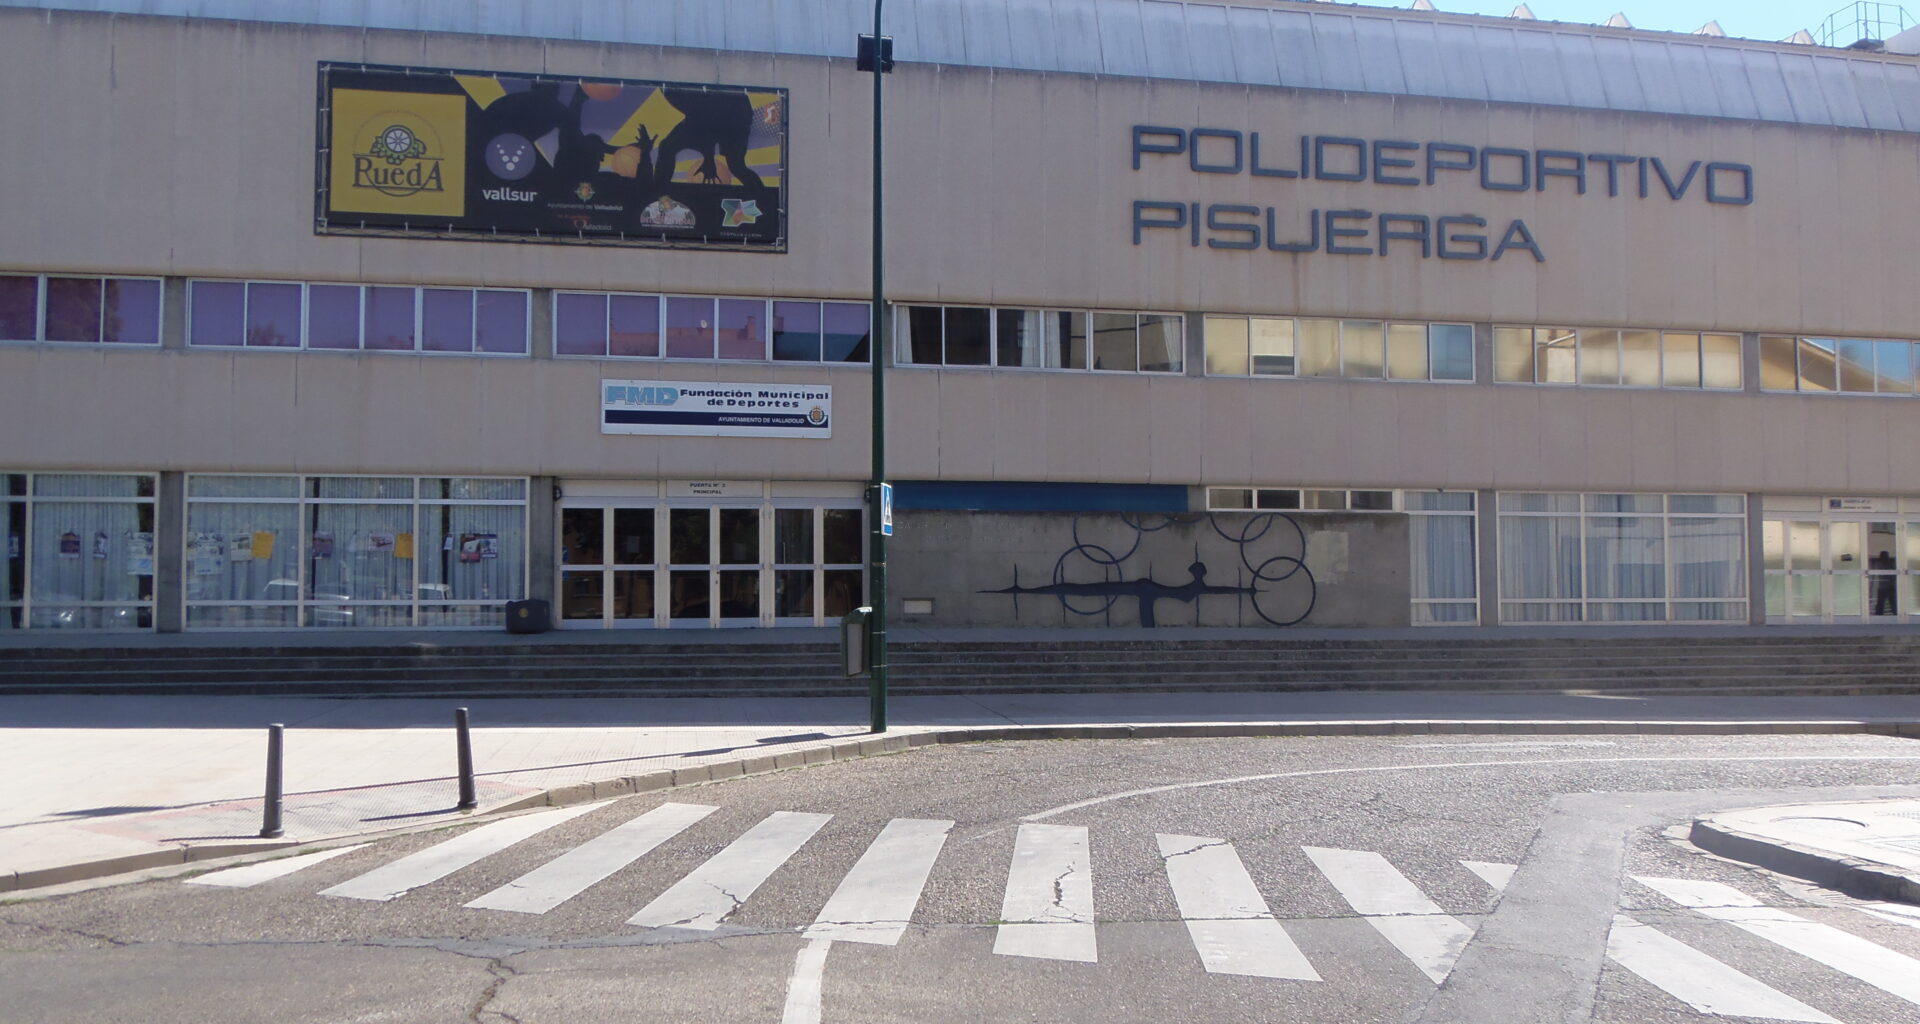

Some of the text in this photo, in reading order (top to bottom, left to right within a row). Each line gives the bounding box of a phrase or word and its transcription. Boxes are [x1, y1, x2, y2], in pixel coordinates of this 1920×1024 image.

[1132, 125, 1753, 205] POLIDEPORTIVO
[482, 187, 537, 203] vallsur
[1132, 201, 1545, 262] PISUERGA
[605, 386, 678, 406] FMD
[680, 389, 829, 400] Fundación Municipal
[707, 398, 800, 408] de Deportes
